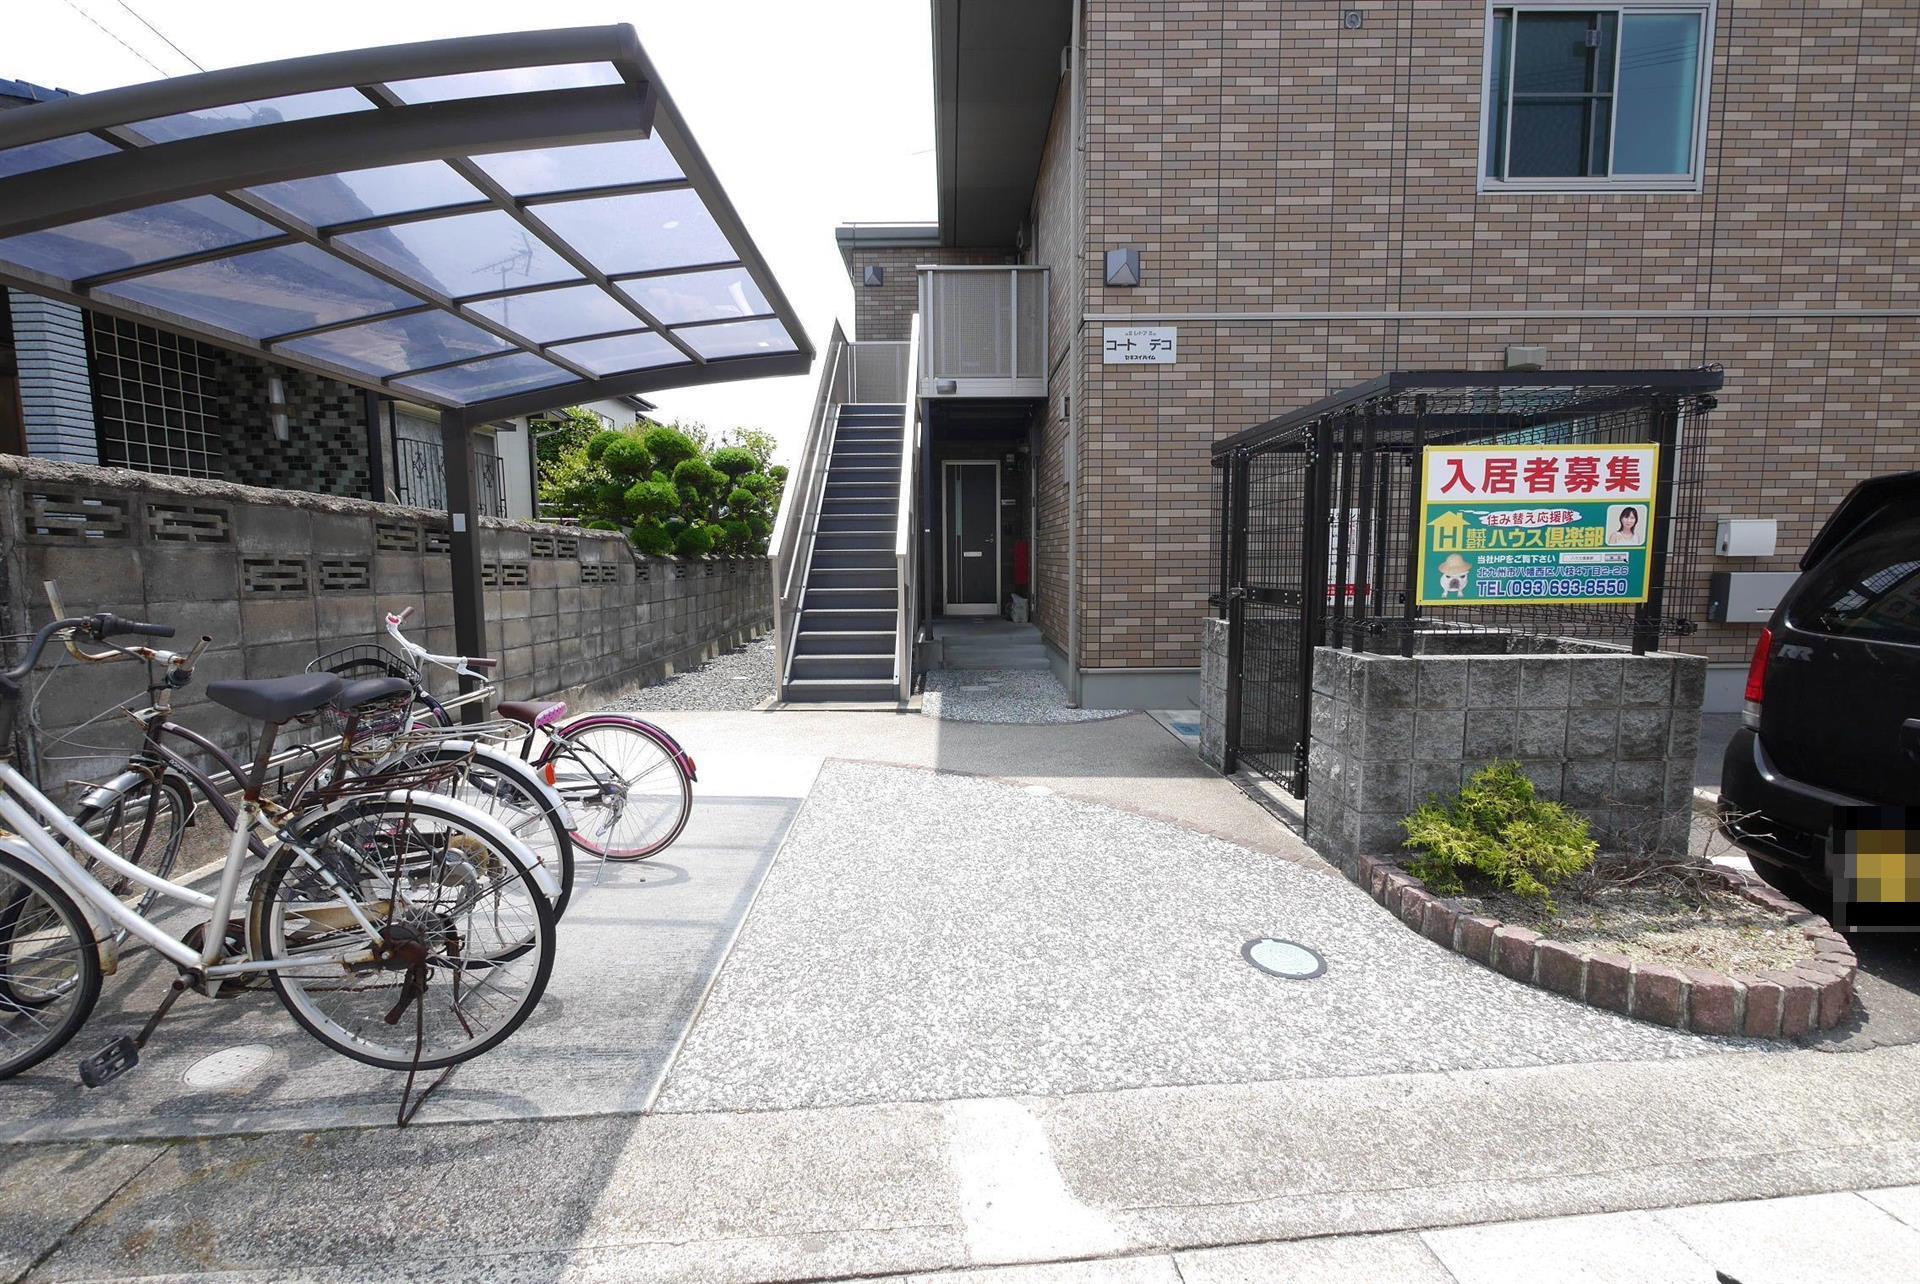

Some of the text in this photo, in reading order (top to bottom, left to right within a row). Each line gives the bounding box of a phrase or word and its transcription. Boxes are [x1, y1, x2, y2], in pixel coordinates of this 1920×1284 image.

[1106, 339, 1171, 351] コート デコ
[1440, 456, 1641, 494] 入居者募集
[1487, 510, 1574, 526] 住み替え応援隊
[1488, 526, 1605, 548] ハウス倶楽部
[1477, 579, 1628, 597] TEL(093)693-8550
[1777, 644, 1814, 662] RR
